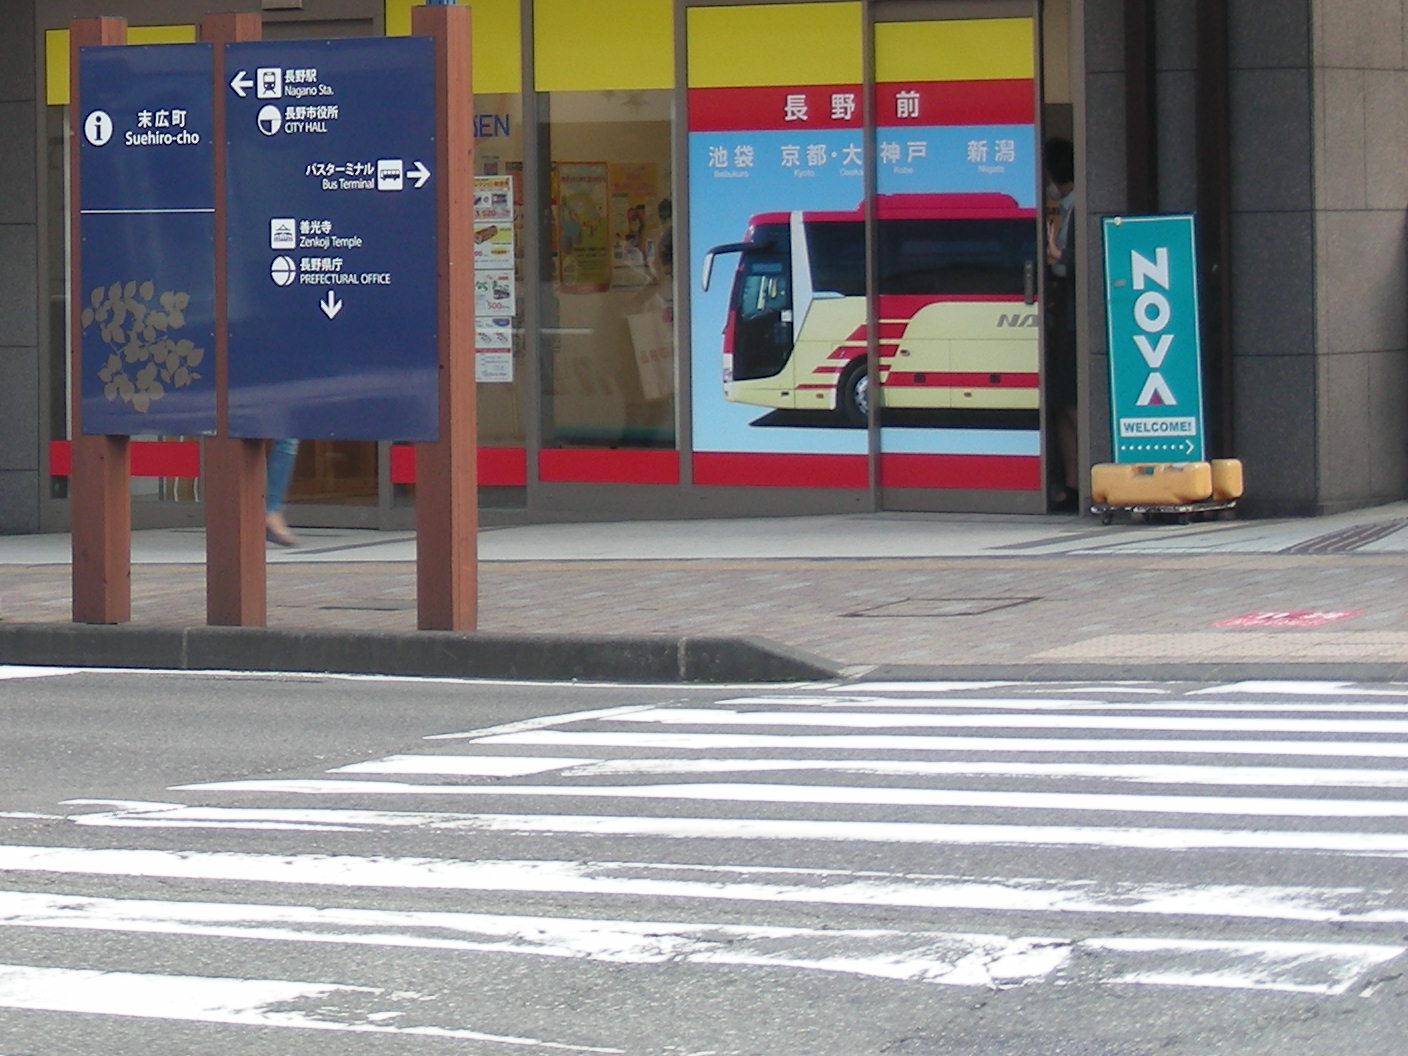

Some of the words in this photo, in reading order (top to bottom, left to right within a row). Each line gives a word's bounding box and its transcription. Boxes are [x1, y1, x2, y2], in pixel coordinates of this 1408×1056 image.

[284, 69, 317, 83] 長野駅
[284, 86, 317, 99] Nagano
[318, 84, 334, 96] Sta.
[137, 110, 187, 128] 末広町
[284, 105, 339, 120] 長野市役所
[284, 121, 305, 134] CITY
[305, 121, 327, 133] HALL
[125, 130, 200, 146] Suehiro-cho
[708, 145, 754, 168] 池袋
[967, 140, 1017, 164] 新潟
[305, 162, 375, 176] バスターミナル
[794, 169, 816, 178] Kyoto
[893, 166, 914, 175] Kobe
[322, 178, 338, 190] Bus
[339, 178, 375, 190] Terminal
[299, 220, 332, 234] 善光寺
[299, 236, 330, 249] Zenkoji
[331, 236, 362, 249] Temple
[300, 257, 343, 272] 長野県庁
[300, 273, 359, 285] PREFECTURAL
[360, 273, 391, 285] OFFICE
[1130, 247, 1178, 407] NOVA
[1123, 421, 1192, 434] WELCOME!
